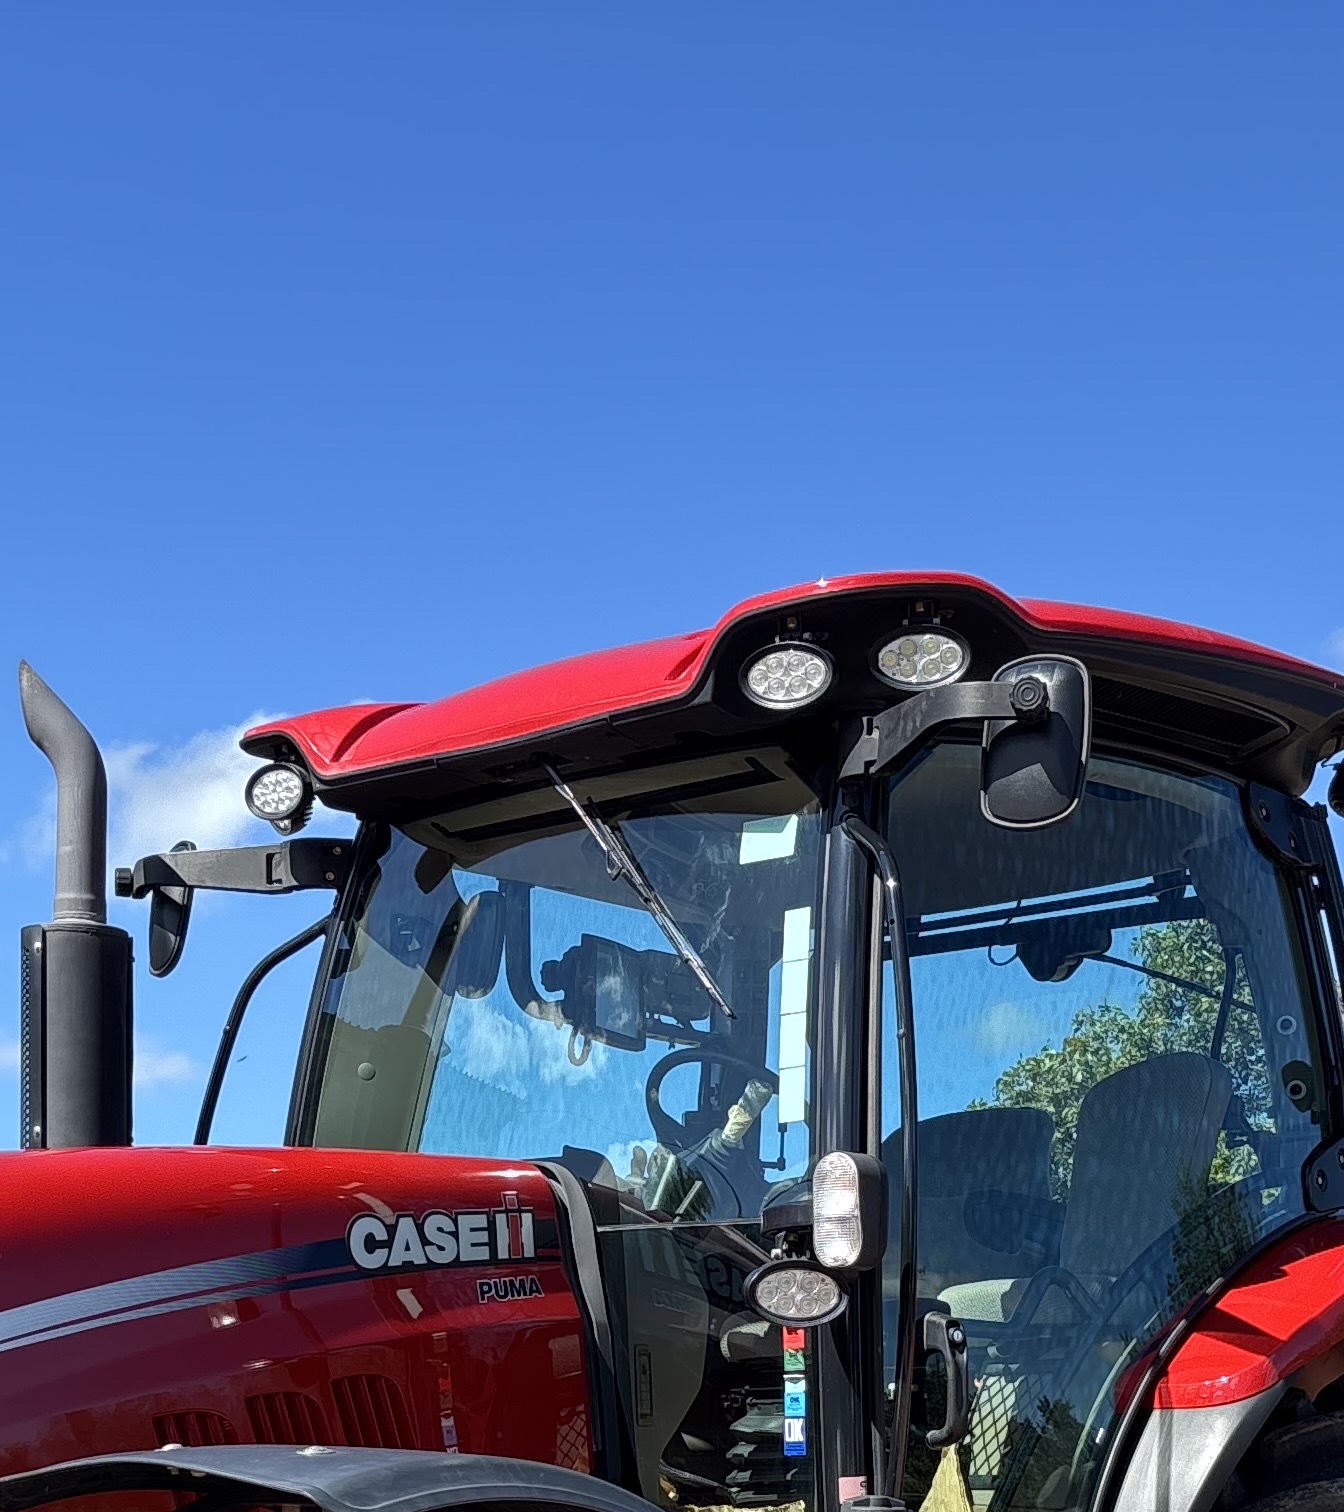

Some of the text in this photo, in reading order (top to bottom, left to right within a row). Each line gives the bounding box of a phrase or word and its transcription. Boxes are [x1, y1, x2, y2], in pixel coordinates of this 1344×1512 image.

[349, 1213, 491, 1270] CASE
[477, 1275, 545, 1304] PUMA
[785, 1418, 805, 1442] OK
